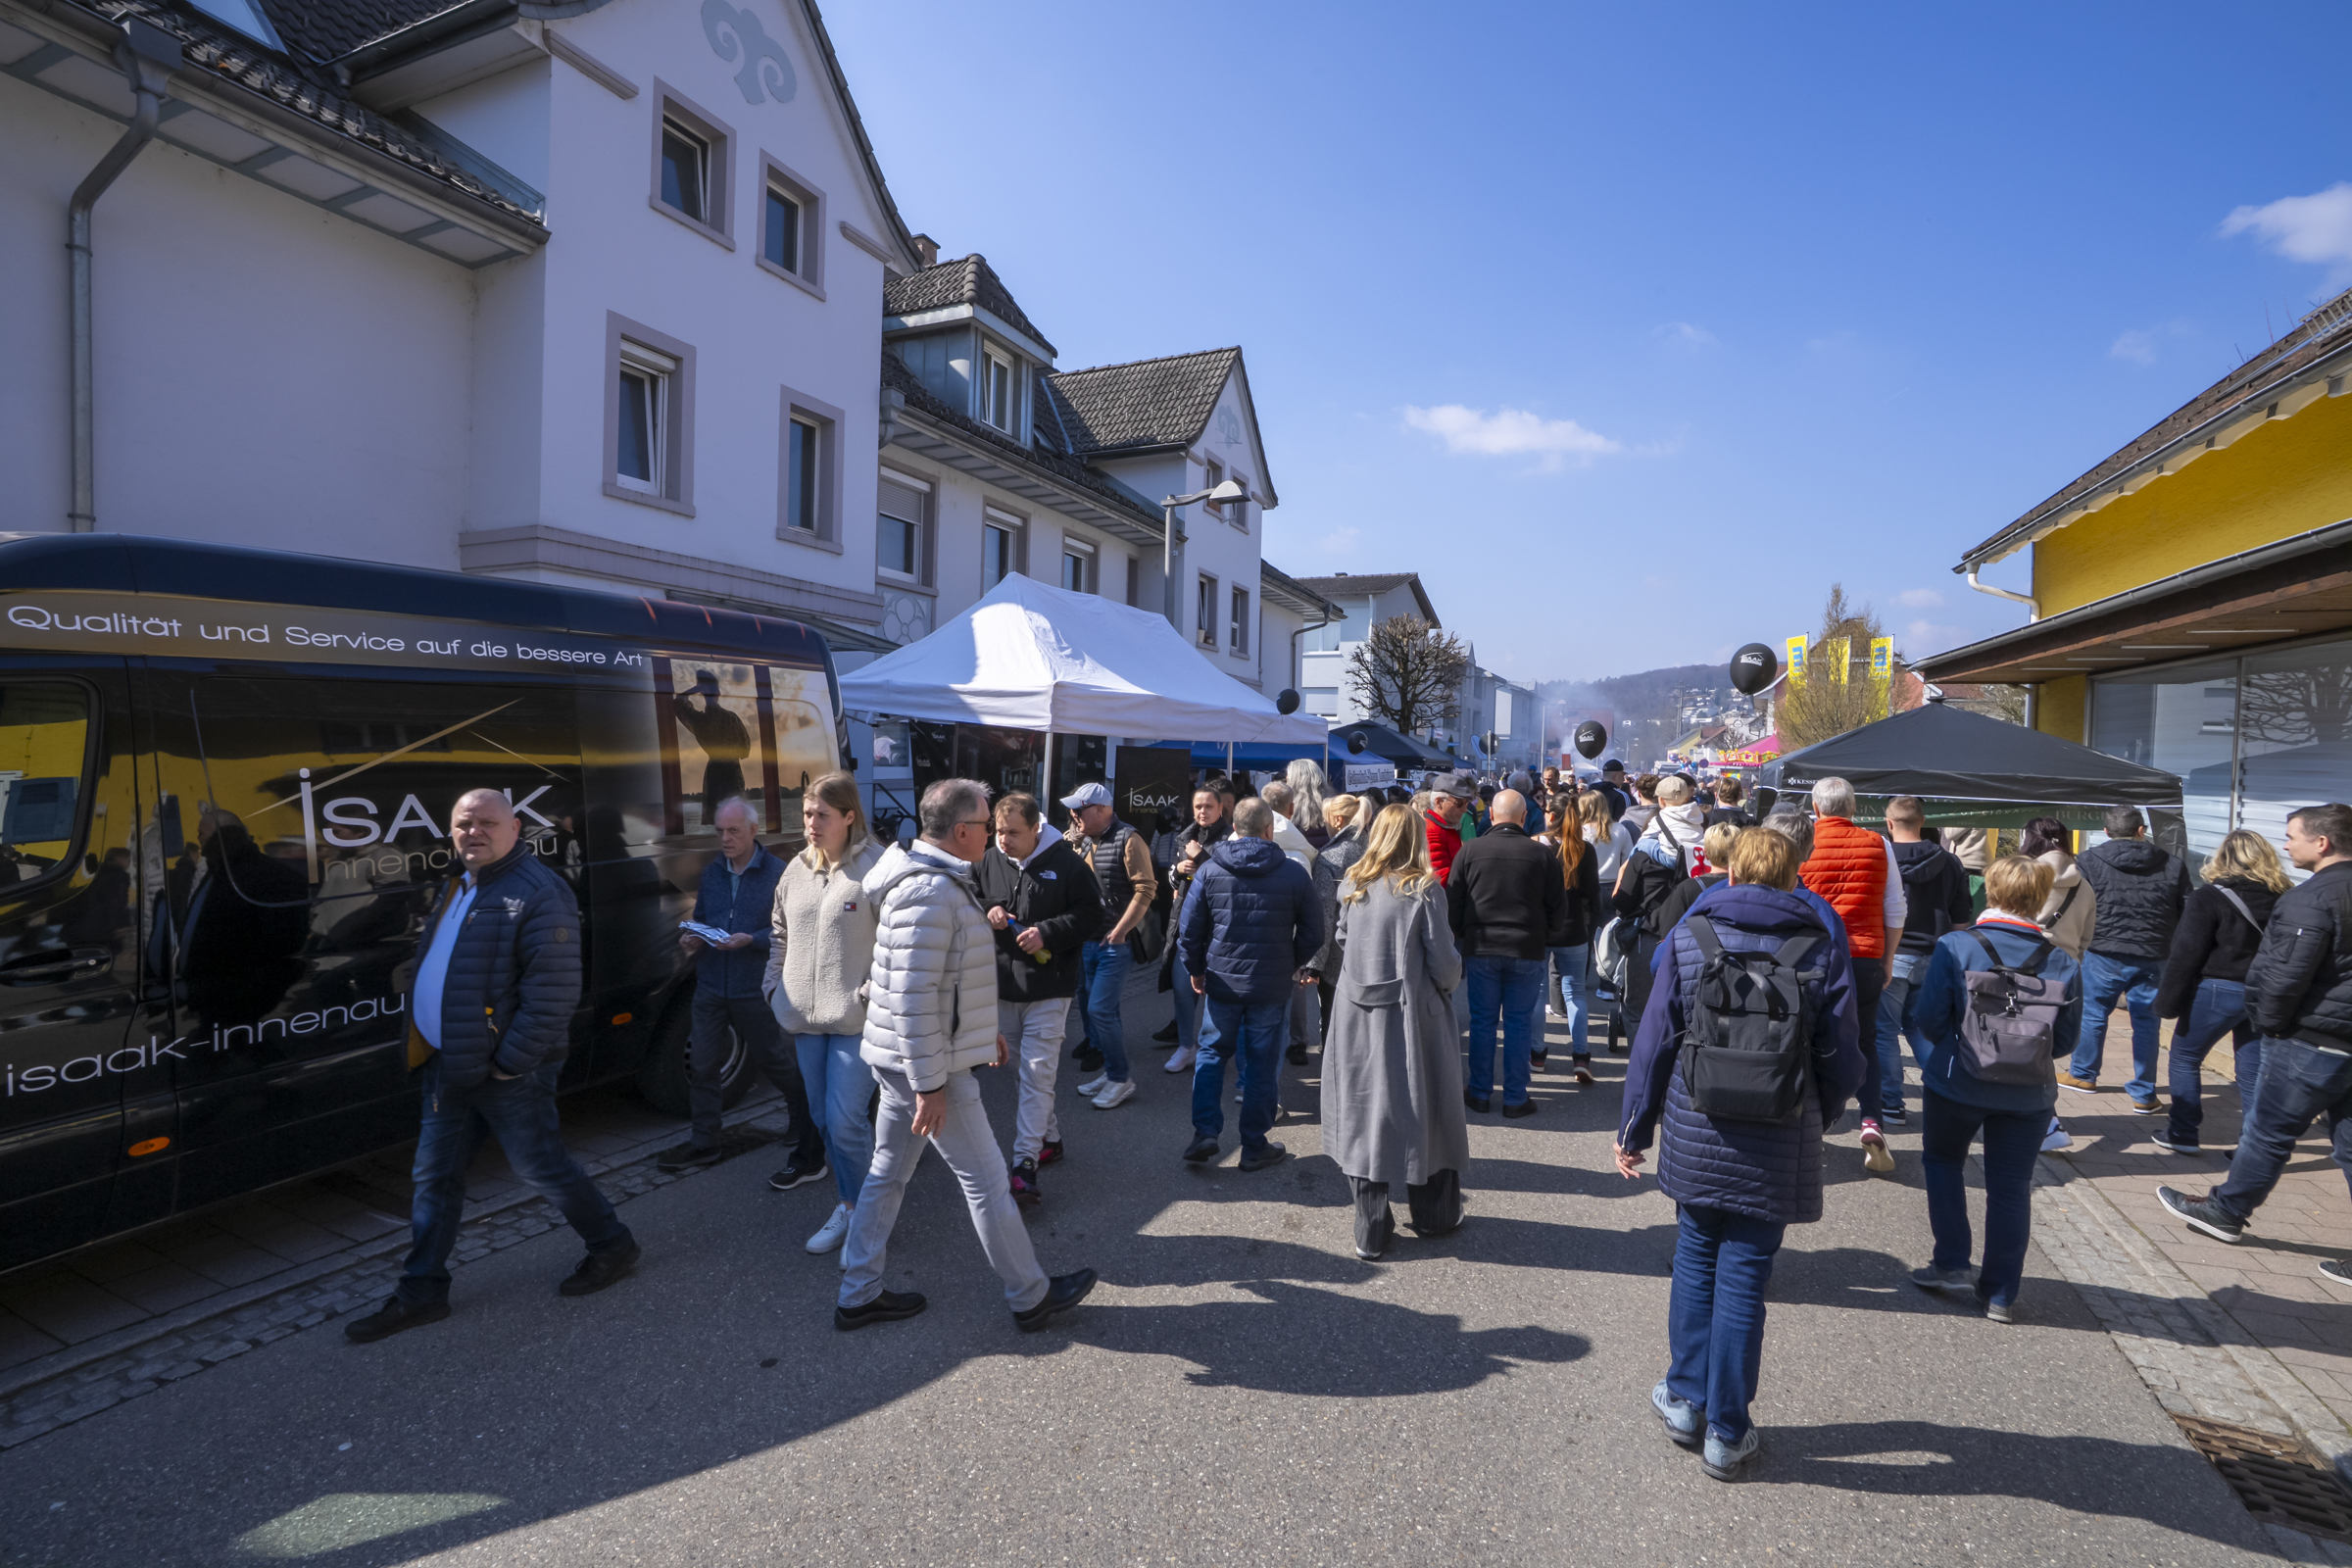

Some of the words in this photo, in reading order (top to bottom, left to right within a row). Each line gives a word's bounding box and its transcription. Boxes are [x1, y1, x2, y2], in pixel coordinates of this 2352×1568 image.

[7, 606, 182, 637] Qualität
[199, 624, 270, 643] und
[285, 626, 406, 652] Service
[416, 639, 462, 656] auf
[470, 640, 508, 658] die
[516, 643, 607, 664] bessere
[613, 651, 643, 666] Art
[7, 993, 406, 1097] isaak-innenau
